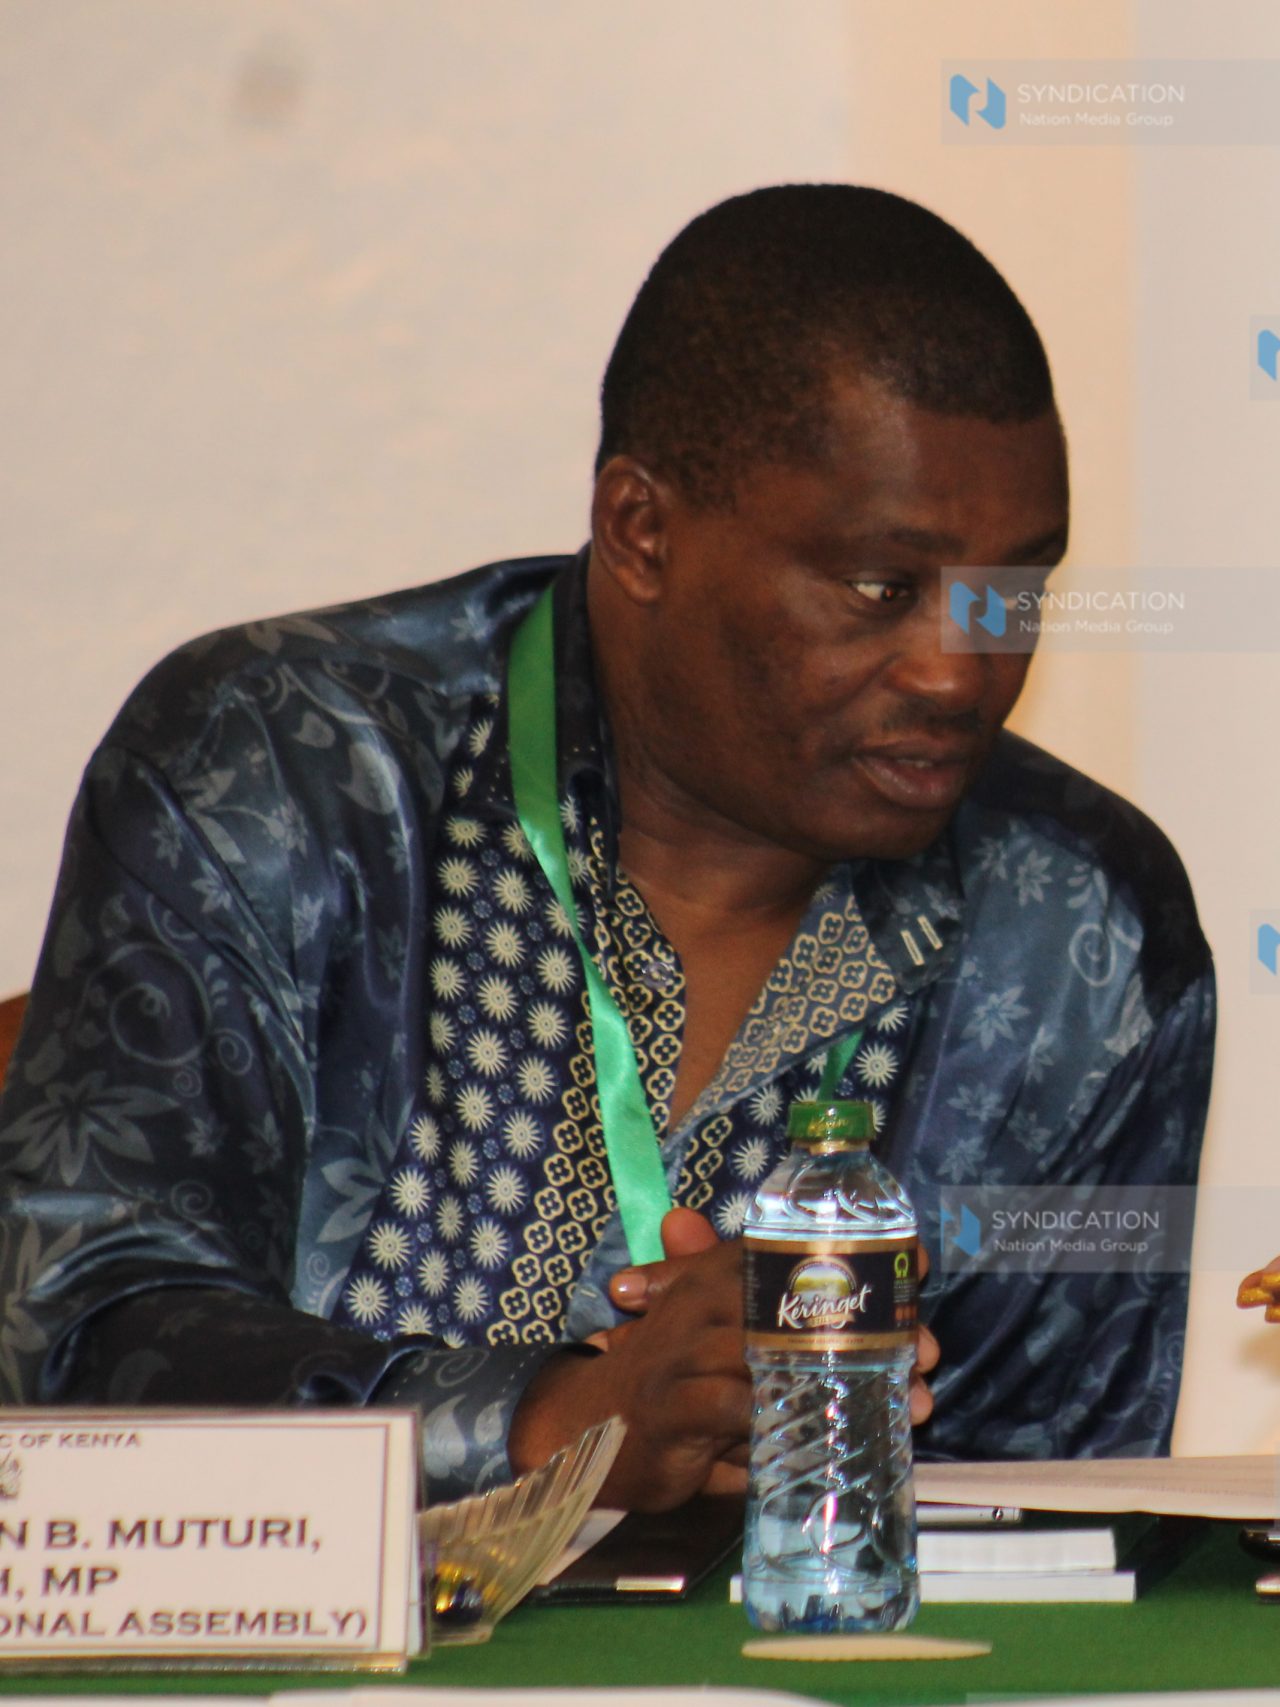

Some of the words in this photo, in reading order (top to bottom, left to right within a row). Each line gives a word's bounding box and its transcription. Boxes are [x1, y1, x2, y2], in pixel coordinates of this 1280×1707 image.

[777, 1284, 872, 1330] Keringet
[19, 1433, 52, 1448] OF
[58, 1432, 142, 1448] KENYA
[45, 1518, 91, 1550] B.
[106, 1517, 323, 1553] MUTURI,
[40, 1565, 120, 1597] MP
[116, 1609, 368, 1640] ASSEMBLY)
